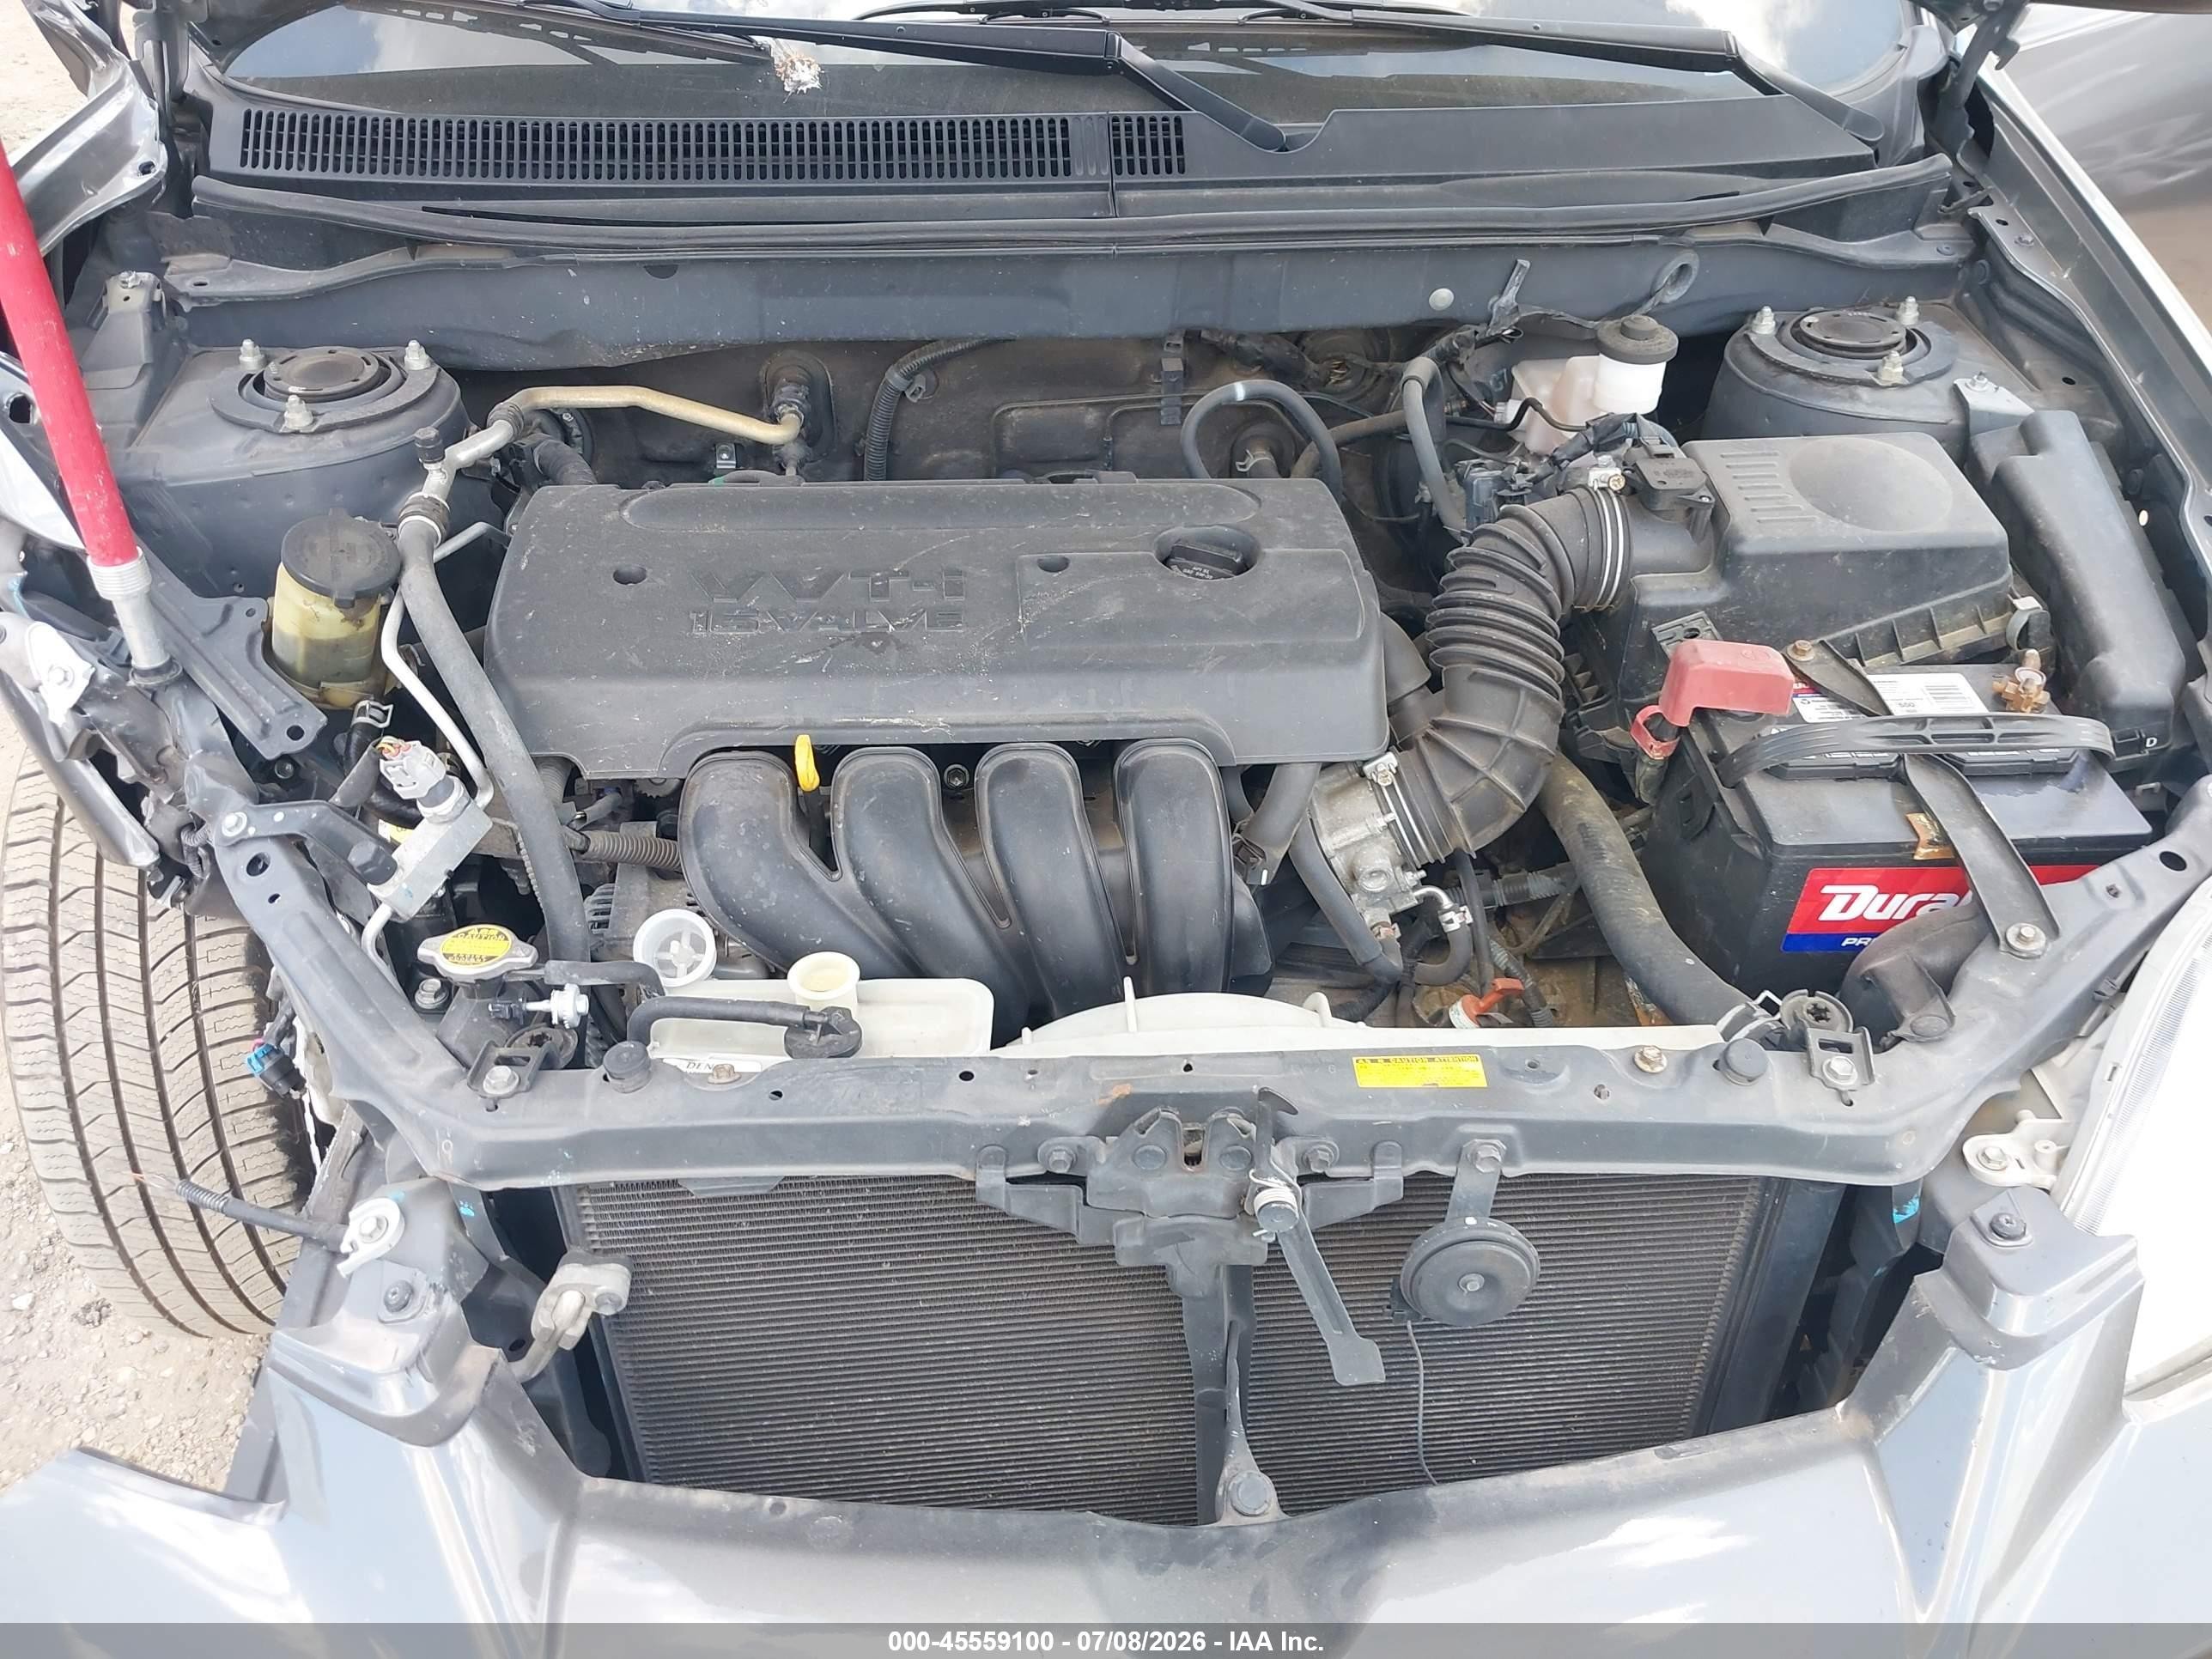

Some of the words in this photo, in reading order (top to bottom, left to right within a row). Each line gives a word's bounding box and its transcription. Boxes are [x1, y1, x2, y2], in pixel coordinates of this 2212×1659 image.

[2145, 737, 2158, 748] D
[1818, 884, 1973, 921] Dura
[686, 1061, 715, 1071] DEN
